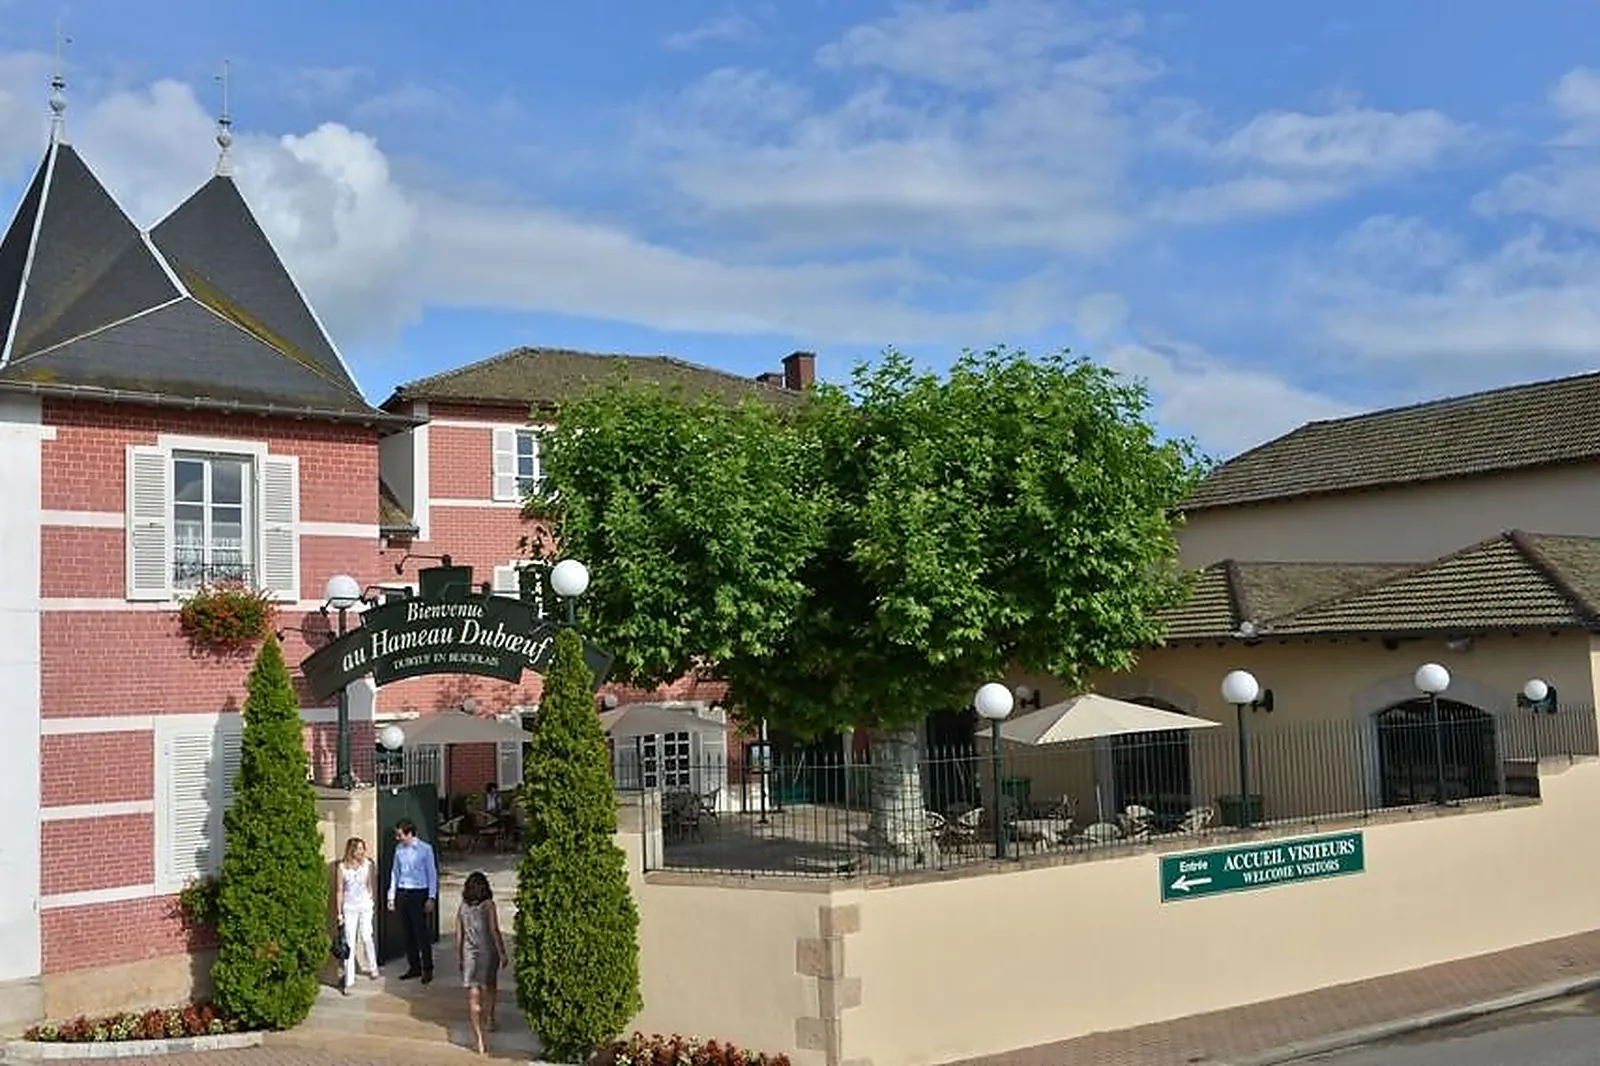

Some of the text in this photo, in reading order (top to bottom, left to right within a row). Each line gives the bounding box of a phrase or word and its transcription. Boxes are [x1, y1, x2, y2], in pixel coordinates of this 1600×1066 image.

[407, 602, 483, 621] Bienvenue
[343, 647, 366, 671] au
[371, 627, 453, 660] Hameau
[1179, 860, 1208, 873] Entrée
[1224, 839, 1355, 871] ACCUEIL VISITEURS
[1243, 859, 1340, 884] WELCOME VISITORS
